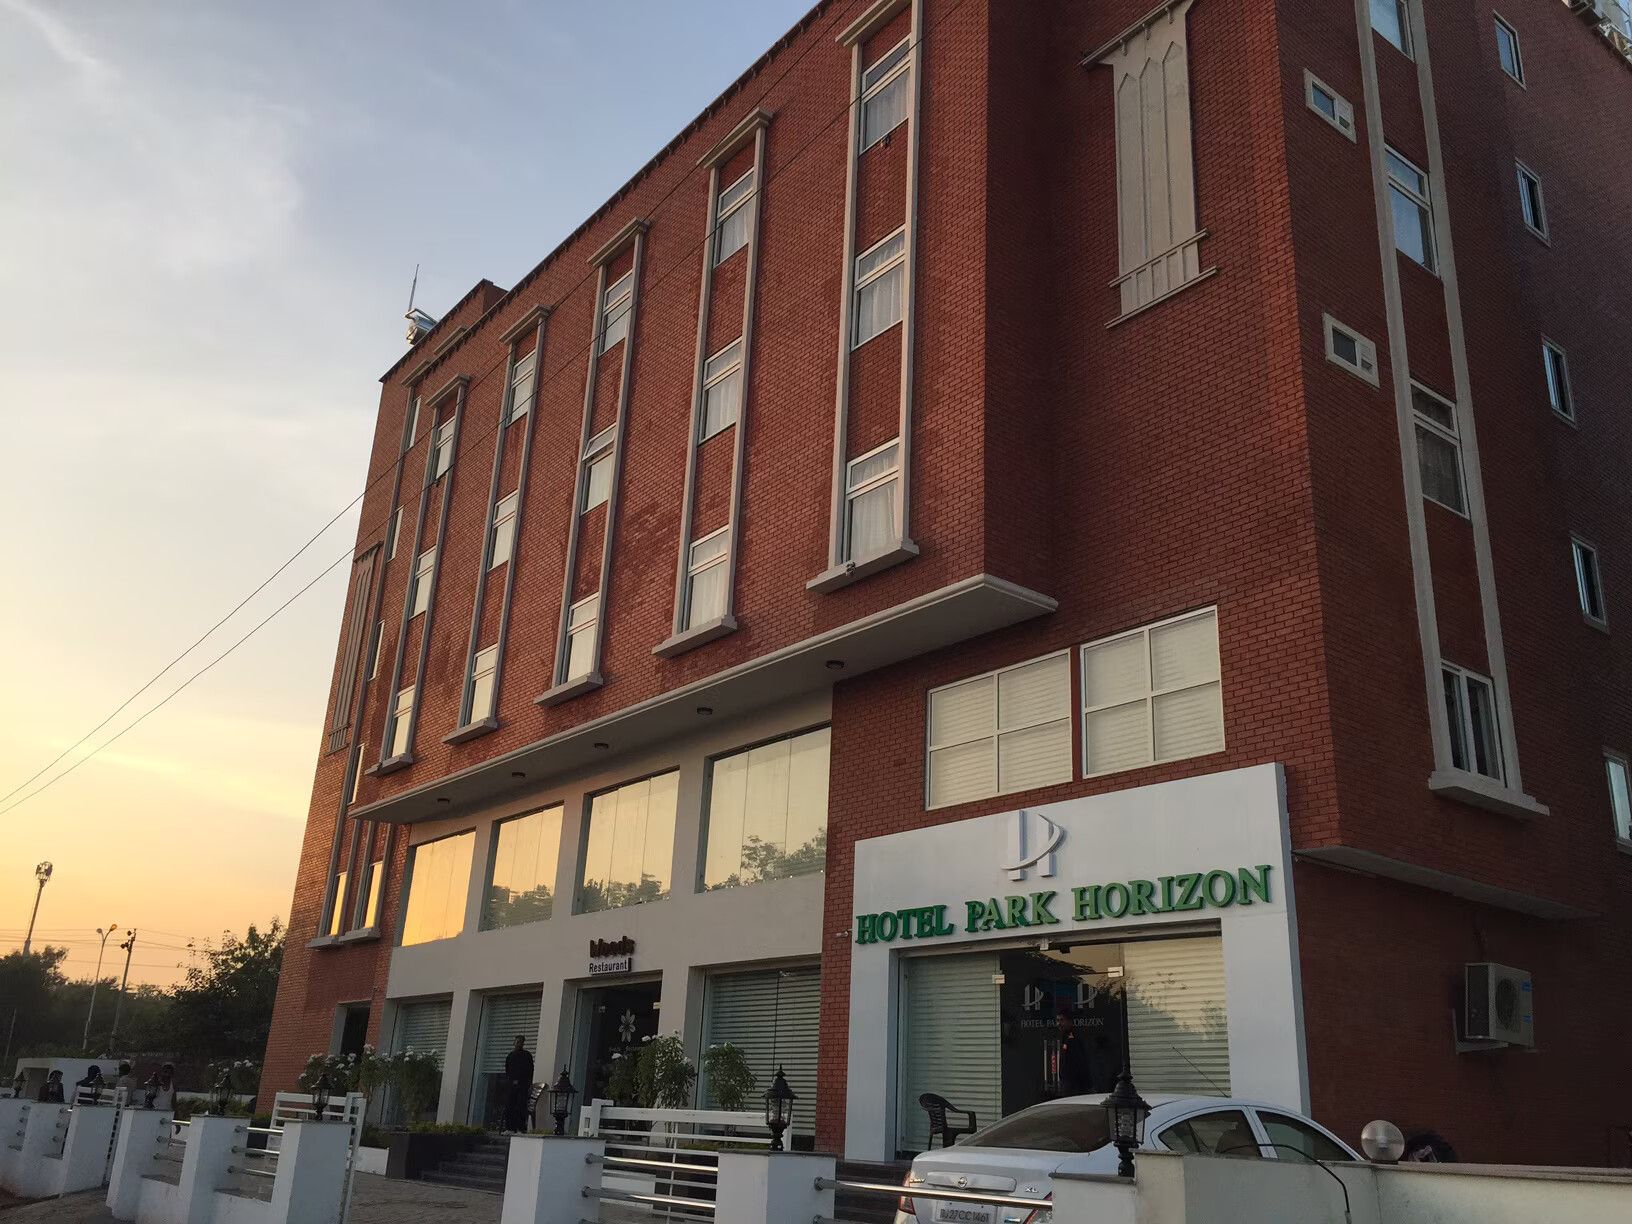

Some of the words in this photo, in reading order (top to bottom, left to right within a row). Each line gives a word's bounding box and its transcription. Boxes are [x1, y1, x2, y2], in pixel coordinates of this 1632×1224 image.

[855, 904, 955, 944] HOTEL
[964, 890, 1059, 931] PARK
[1071, 864, 1274, 921] HORIZON
[589, 960, 628, 973] Restaurant
[1073, 1017, 1105, 1027] ORIZON
